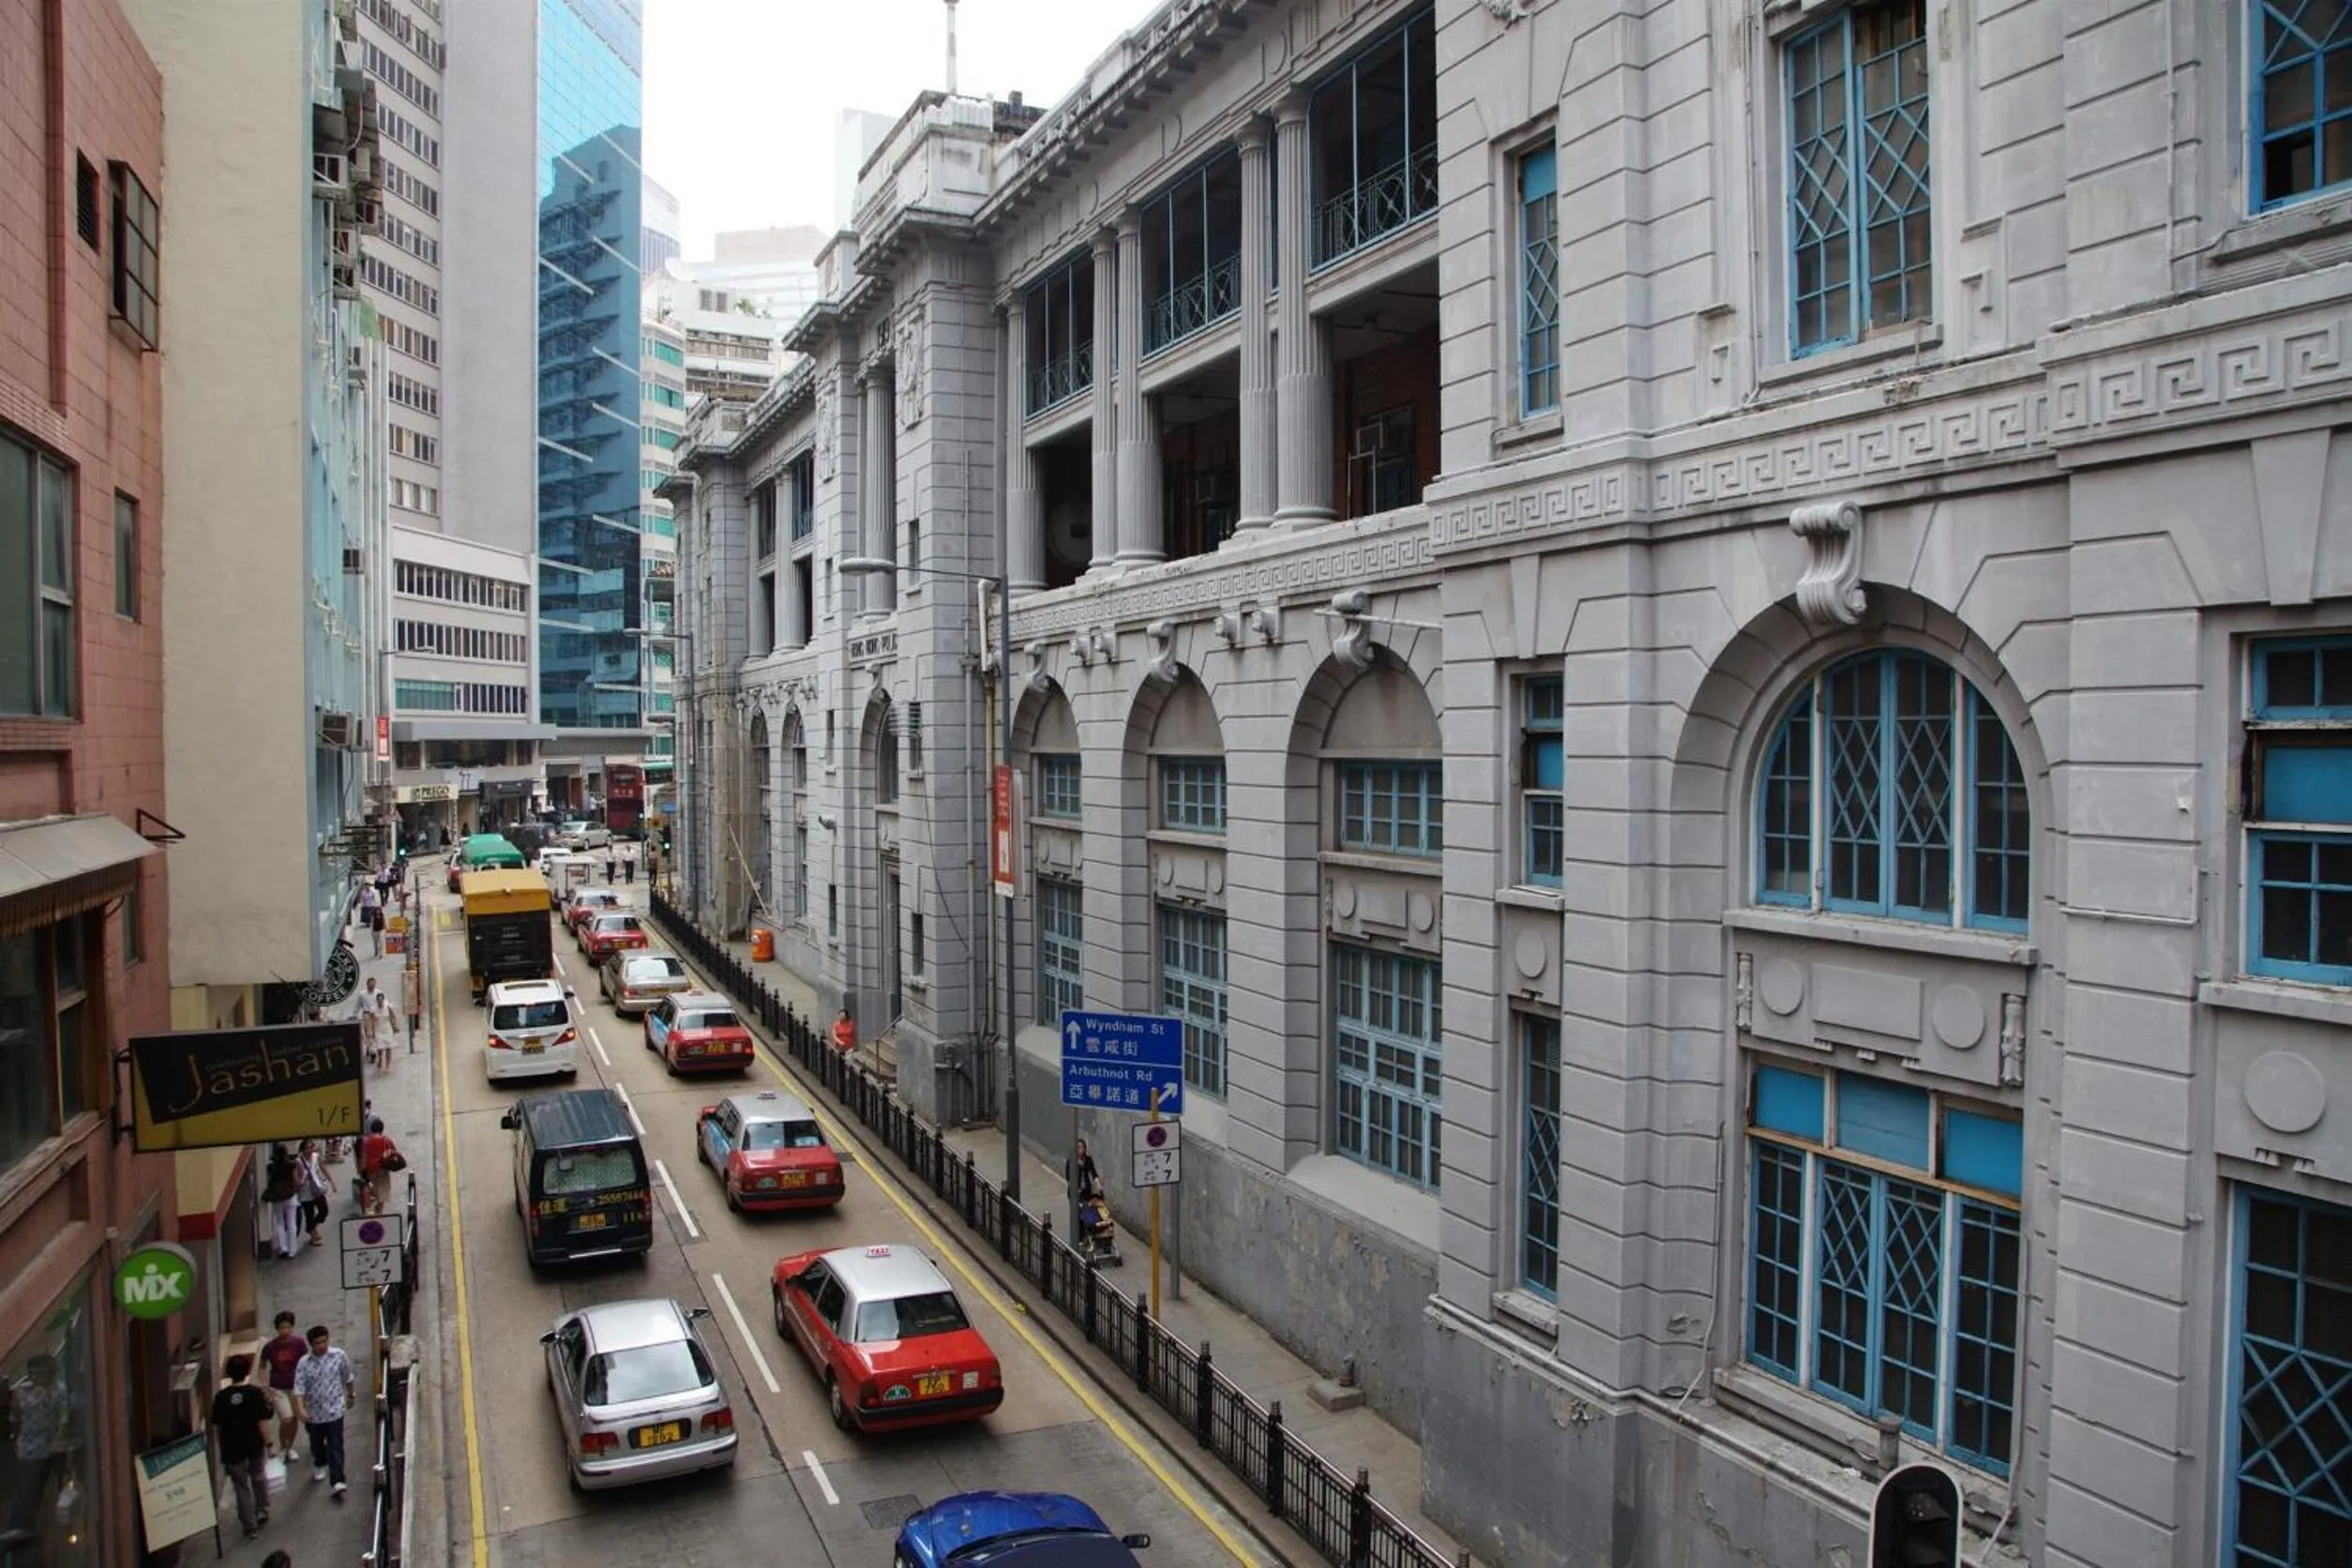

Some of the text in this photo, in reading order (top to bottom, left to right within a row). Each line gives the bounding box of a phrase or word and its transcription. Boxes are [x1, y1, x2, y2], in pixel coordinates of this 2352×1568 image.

[302, 987, 348, 1003] COFFEE
[1086, 1018, 1165, 1035] Wyndham St
[167, 1038, 351, 1113] Jashan
[1069, 1064, 1153, 1082] Arbuthnot Rd
[317, 1105, 352, 1126] 1/F
[1163, 1152, 1171, 1164] 7
[1164, 1168, 1172, 1181] 7
[380, 1249, 390, 1262] 7
[381, 1269, 391, 1281] 7
